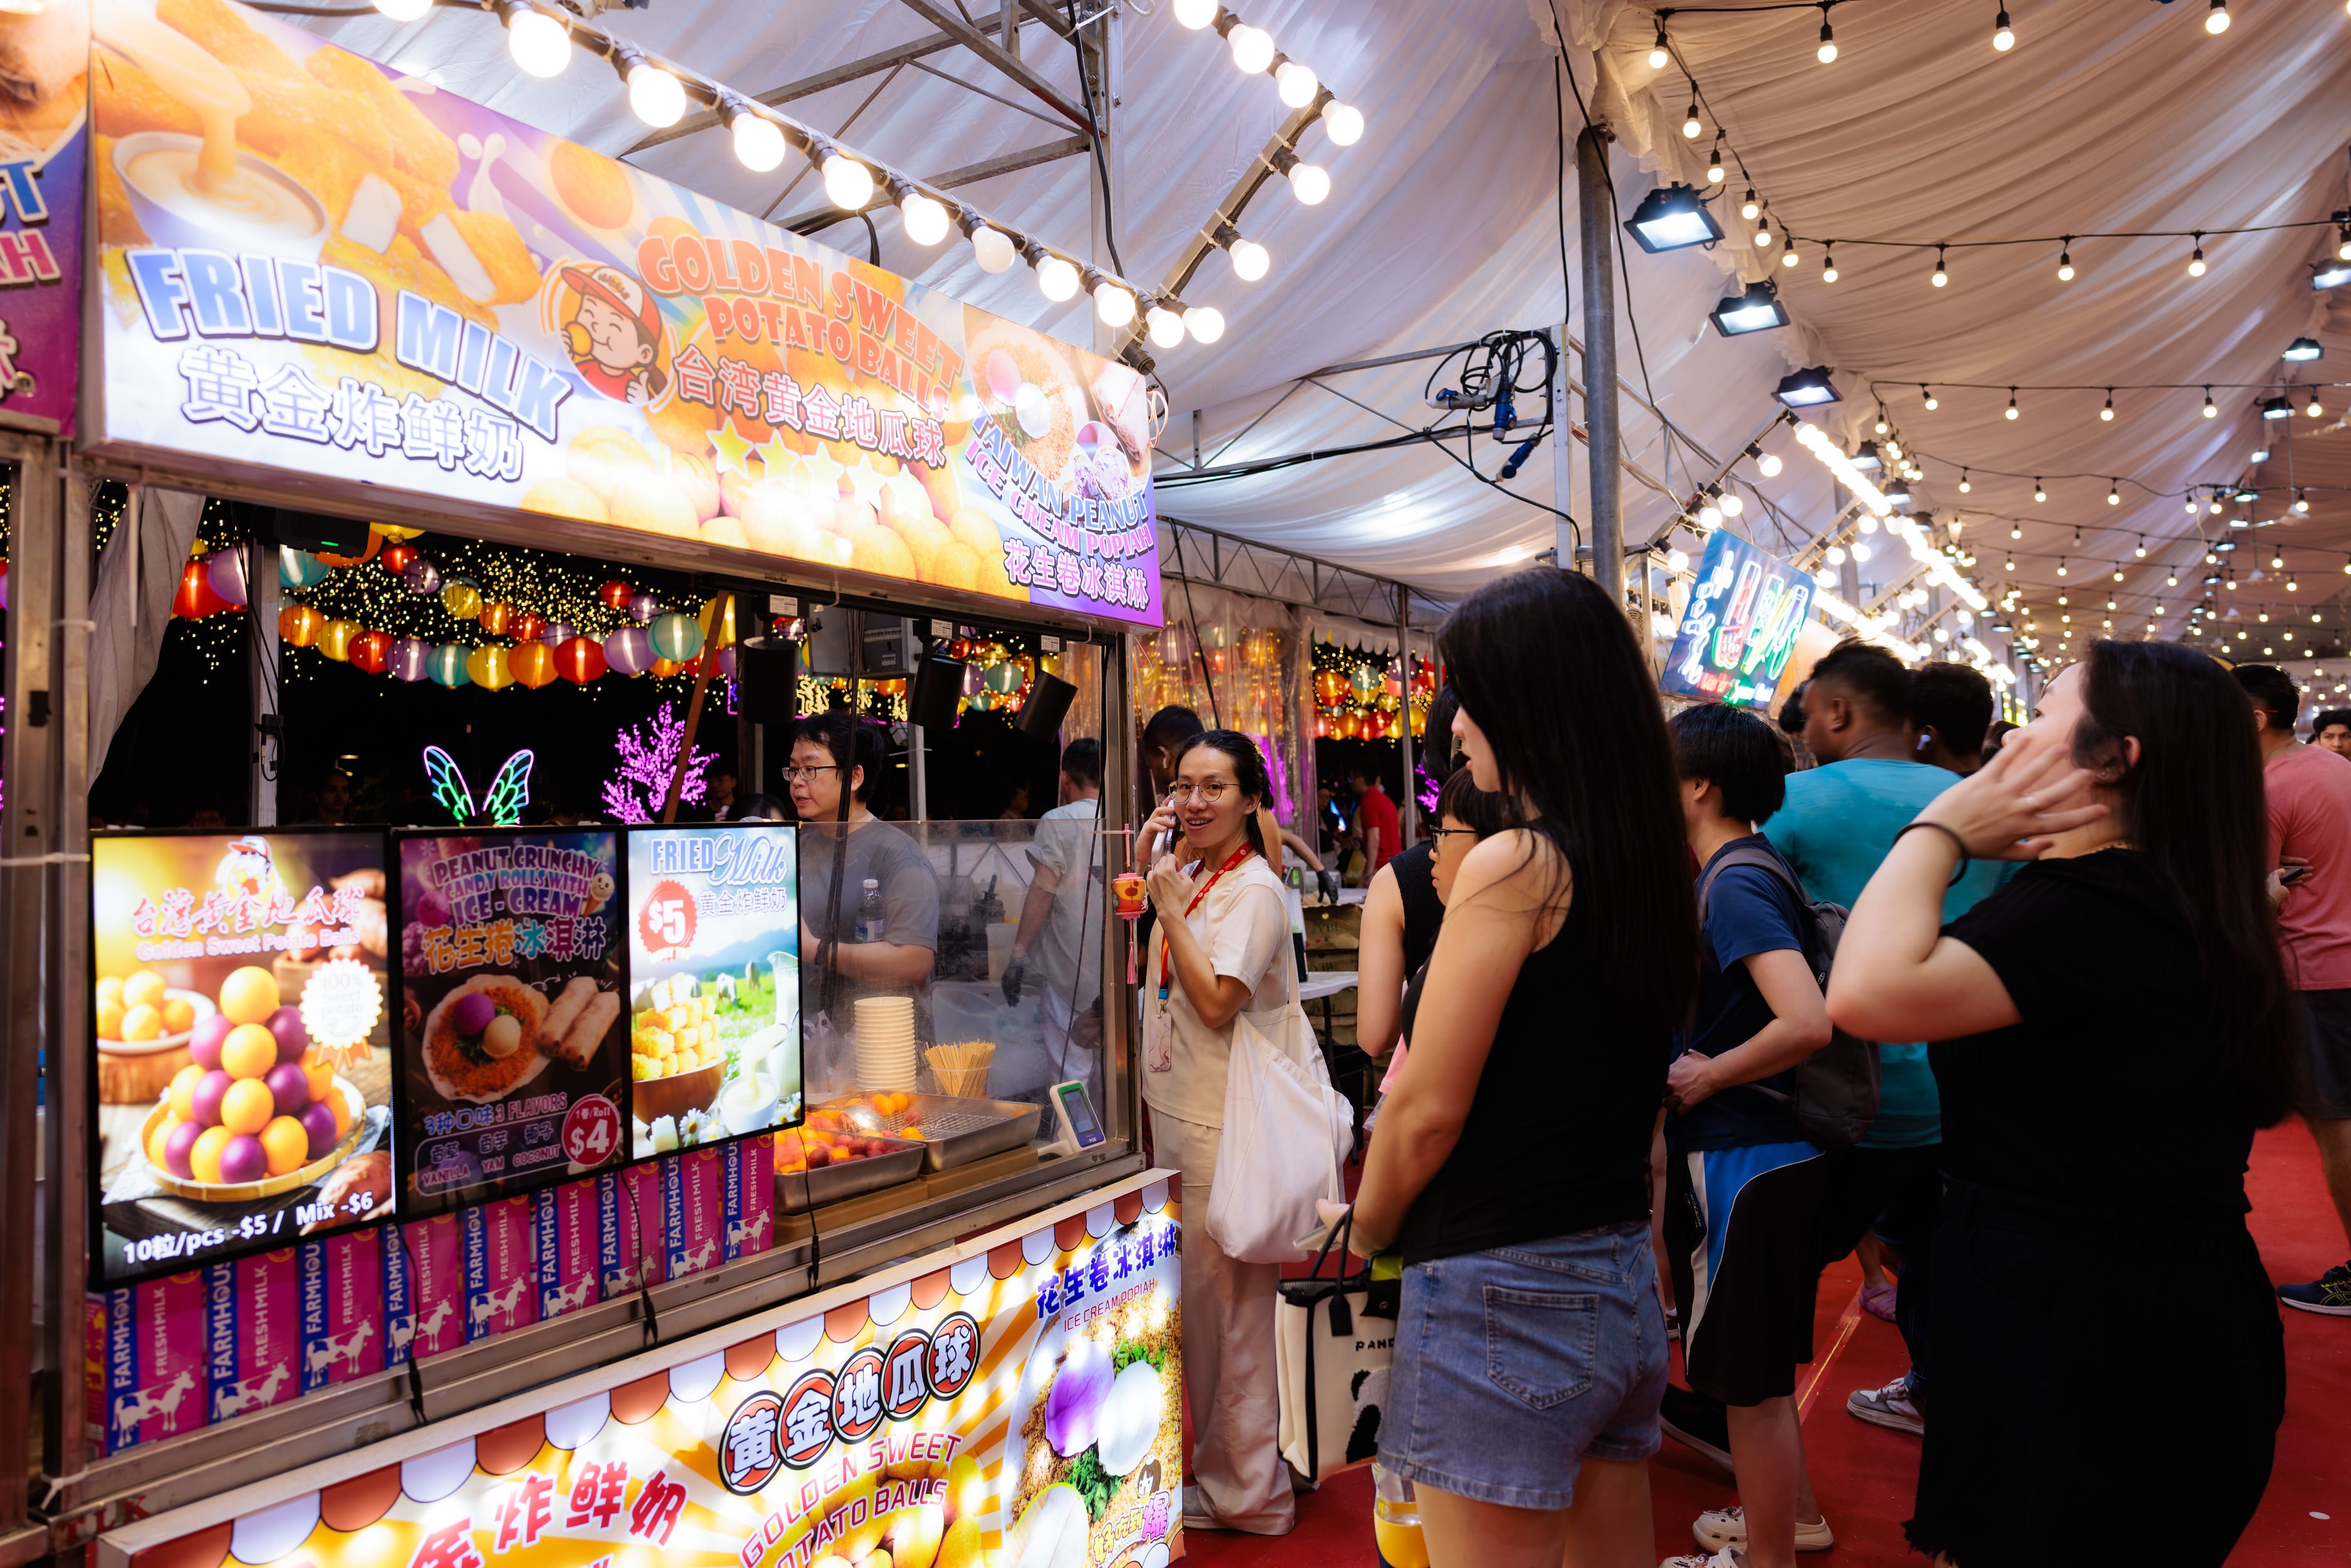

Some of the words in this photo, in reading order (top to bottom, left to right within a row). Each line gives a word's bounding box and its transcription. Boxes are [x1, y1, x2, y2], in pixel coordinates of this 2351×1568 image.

[637, 235, 824, 311] GOLDEN
[830, 271, 964, 389] SWEET
[126, 247, 379, 352] FRIED
[396, 289, 573, 443] MILK
[703, 296, 853, 361] POTATO
[853, 329, 950, 424] BALLS
[179, 344, 523, 482] 黄金炸鲜奶
[674, 344, 946, 470] 台湾黄金地瓜球
[972, 400, 1063, 519] TAIWAN
[1069, 489, 1149, 532] PEANUT
[965, 439, 1007, 500] ICE
[1009, 490, 1081, 554] CREAM
[1086, 524, 1154, 560] POPIAH
[1003, 538, 1150, 611] 花生卷冰淇淋
[432, 845, 511, 887] PEANUT
[512, 844, 600, 879] CRUNCHY
[650, 837, 716, 874] FRIED
[707, 832, 788, 886] Milk
[443, 871, 497, 903] CANDY
[499, 867, 546, 889] ROLLS
[546, 870, 590, 898] WITH
[452, 889, 493, 928] ICE
[507, 886, 583, 919] CREAM
[699, 886, 787, 918] 黄金炸鲜奶
[136, 938, 204, 961] Golden
[206, 935, 262, 956] Sweet
[262, 931, 318, 951] Potato
[319, 928, 361, 948] Balls
[648, 899, 687, 945] $5
[423, 1104, 494, 1136] 3种口味
[495, 1103, 506, 1122] 3
[507, 1091, 568, 1120] FLAVORS
[512, 1143, 561, 1167] COCONUT
[570, 1118, 610, 1159] $4
[422, 1163, 470, 1187] VANILLA
[482, 1155, 505, 1173] YAM
[691, 1161, 701, 1195] MILK
[231, 1214, 268, 1239] -$5
[272, 1210, 285, 1234] /
[295, 1202, 336, 1226] Mix
[340, 1191, 374, 1215] -$6
[498, 1206, 508, 1238] MILK
[569, 1189, 579, 1226] MILK
[669, 1156, 682, 1248] FARMHOUS
[694, 1196, 703, 1241] FRESH
[418, 1225, 430, 1259] MILK
[467, 1207, 484, 1289] FARMHOU
[499, 1239, 509, 1281] FRESH
[541, 1189, 556, 1284] FARMHOU
[570, 1227, 580, 1274] FRESH
[341, 1243, 353, 1279] MILK
[386, 1224, 403, 1311] FARMHOU
[421, 1260, 432, 1303] FRESH
[1037, 1223, 1177, 1320] 花生卷冰淇淋
[152, 1286, 166, 1325] MILK
[254, 1264, 268, 1310] MILK
[305, 1242, 322, 1334] FARMHOU
[342, 1279, 353, 1325] FRESH
[1064, 1306, 1081, 1333] ICE
[1083, 1295, 1120, 1325] CREAM
[1120, 1277, 1155, 1305] POPIAH
[113, 1288, 132, 1389] FARMHOU
[154, 1325, 168, 1376] FRESH
[255, 1310, 268, 1367] FRESH
[1356, 1337, 1395, 1352] PAND
[728, 1323, 973, 1481] 黄金地瓜球
[409, 1461, 687, 1568] 金炸鲜奶
[741, 1454, 859, 1568] GOLDEN
[868, 1433, 962, 1467] SWEET
[777, 1498, 868, 1568] OTATO
[873, 1478, 949, 1518] BALLS
[1093, 1490, 1170, 1565] 好吃到爆
